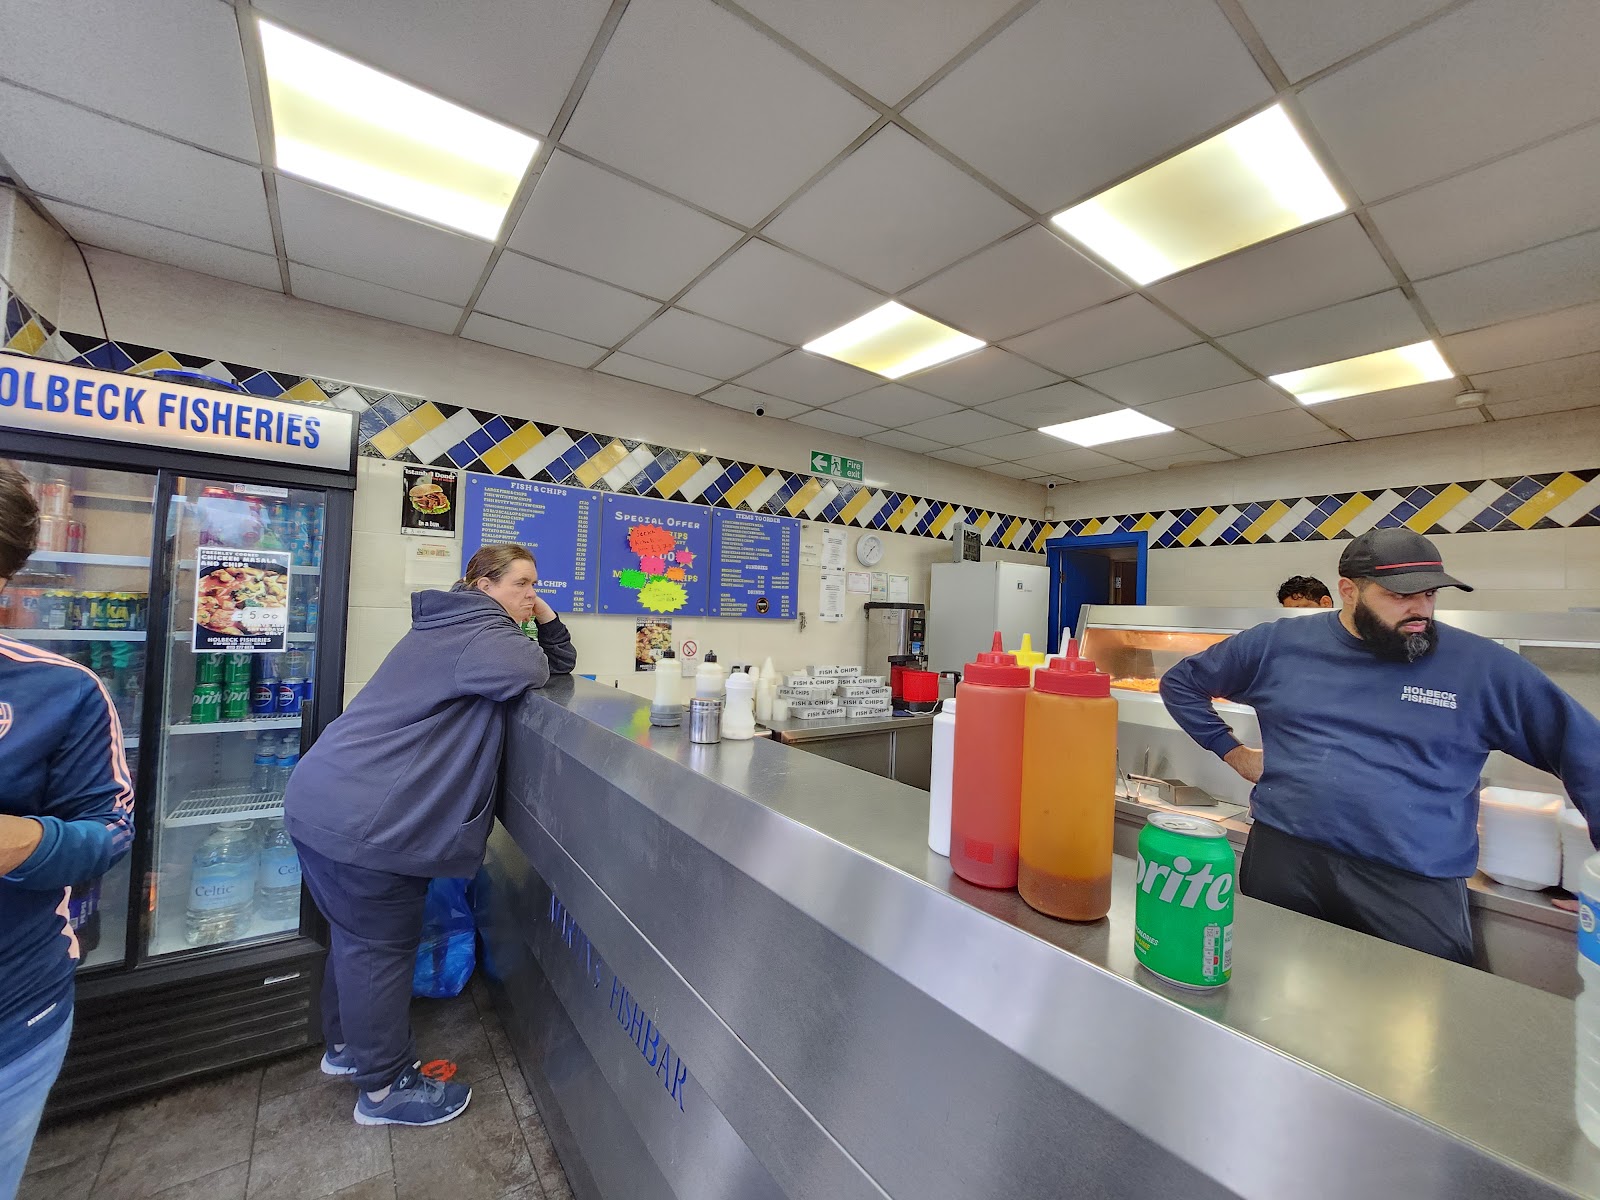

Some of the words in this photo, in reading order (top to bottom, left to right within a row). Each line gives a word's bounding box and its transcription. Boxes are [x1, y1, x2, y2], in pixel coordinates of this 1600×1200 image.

[0, 367, 147, 424] OLBECK
[158, 392, 321, 449] FISHERIES
[846, 460, 860, 470] Fire
[846, 470, 860, 478] exit
[511, 482, 532, 492] FISH
[540, 487, 567, 496] CHIPS
[1404, 686, 1457, 701] HOLBECK
[1401, 694, 1457, 709] FISHERIES
[195, 885, 234, 897] Celtic
[610, 976, 687, 1113] FISHBAR
